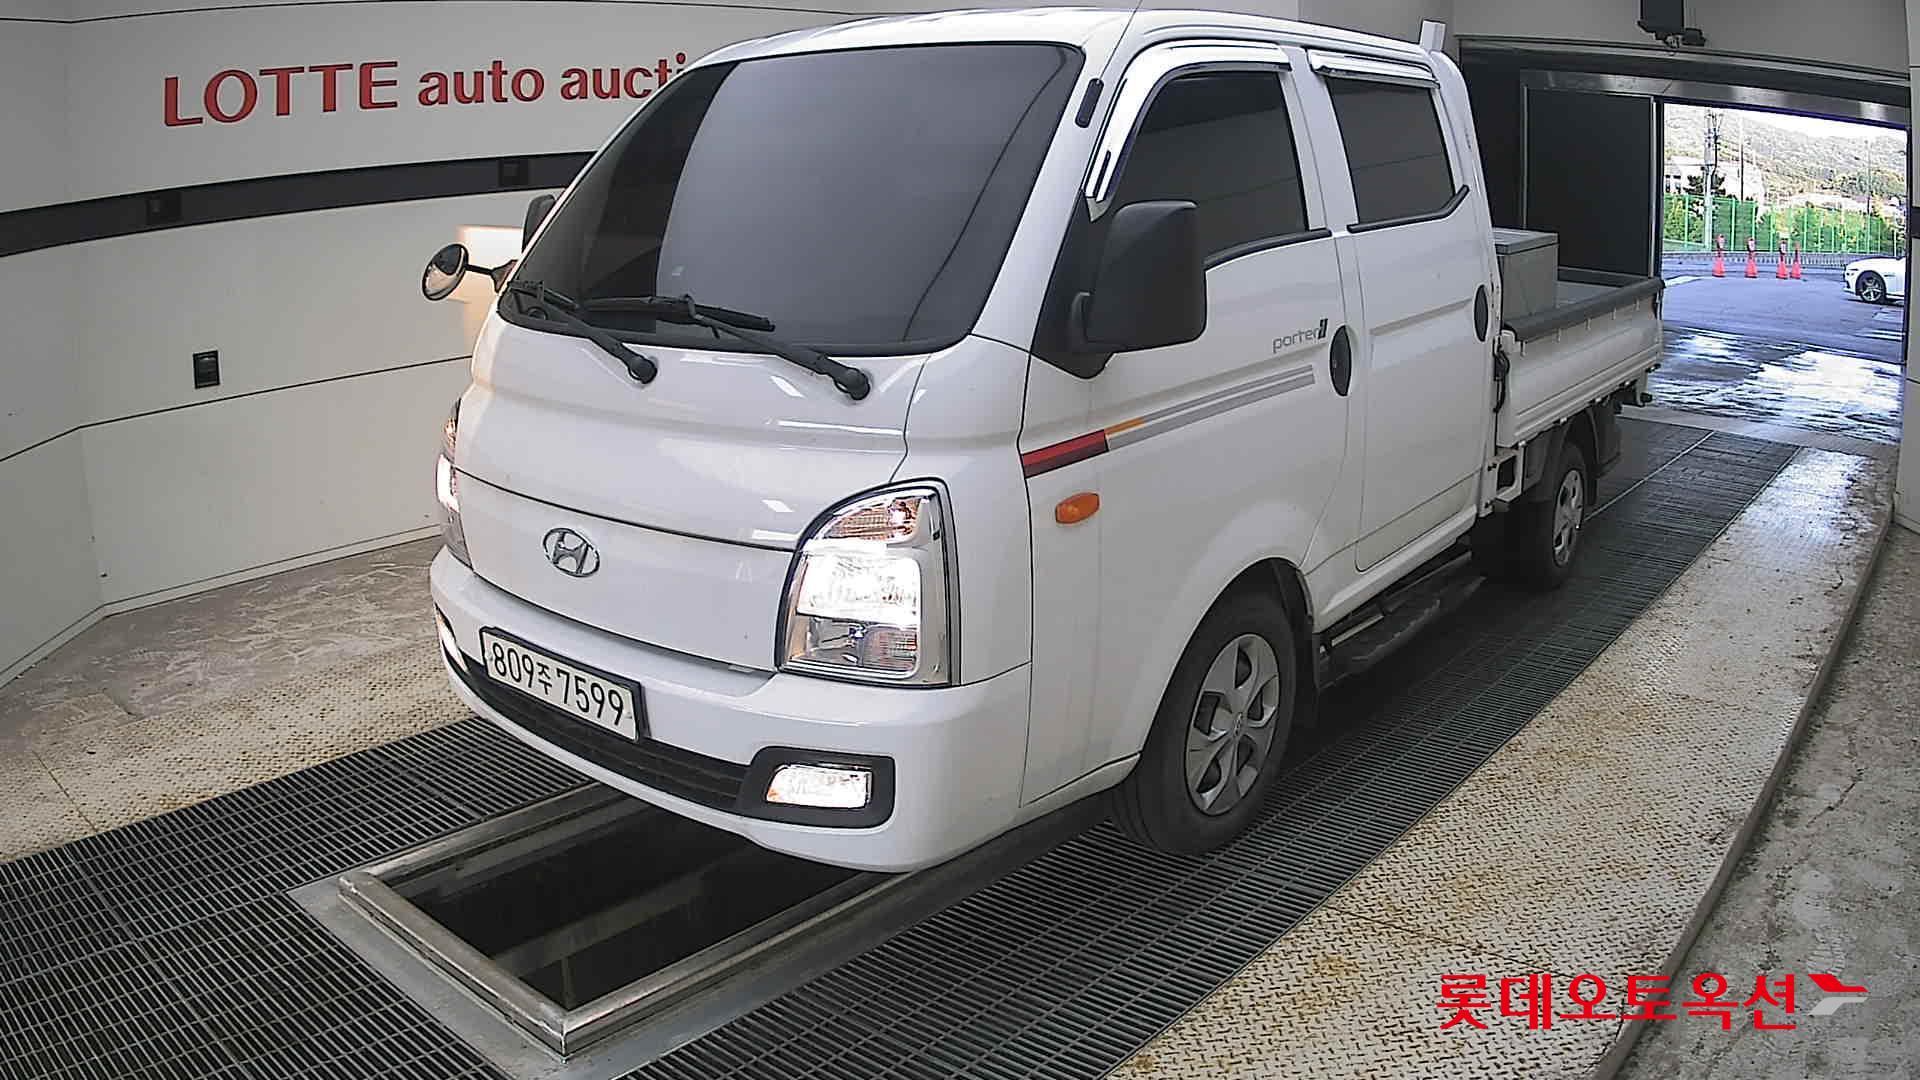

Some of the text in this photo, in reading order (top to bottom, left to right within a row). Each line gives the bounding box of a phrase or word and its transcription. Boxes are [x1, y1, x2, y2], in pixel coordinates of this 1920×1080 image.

[164, 61, 399, 127] LOTTE
[417, 60, 545, 106] auto
[492, 642, 624, 726] 809주7599
